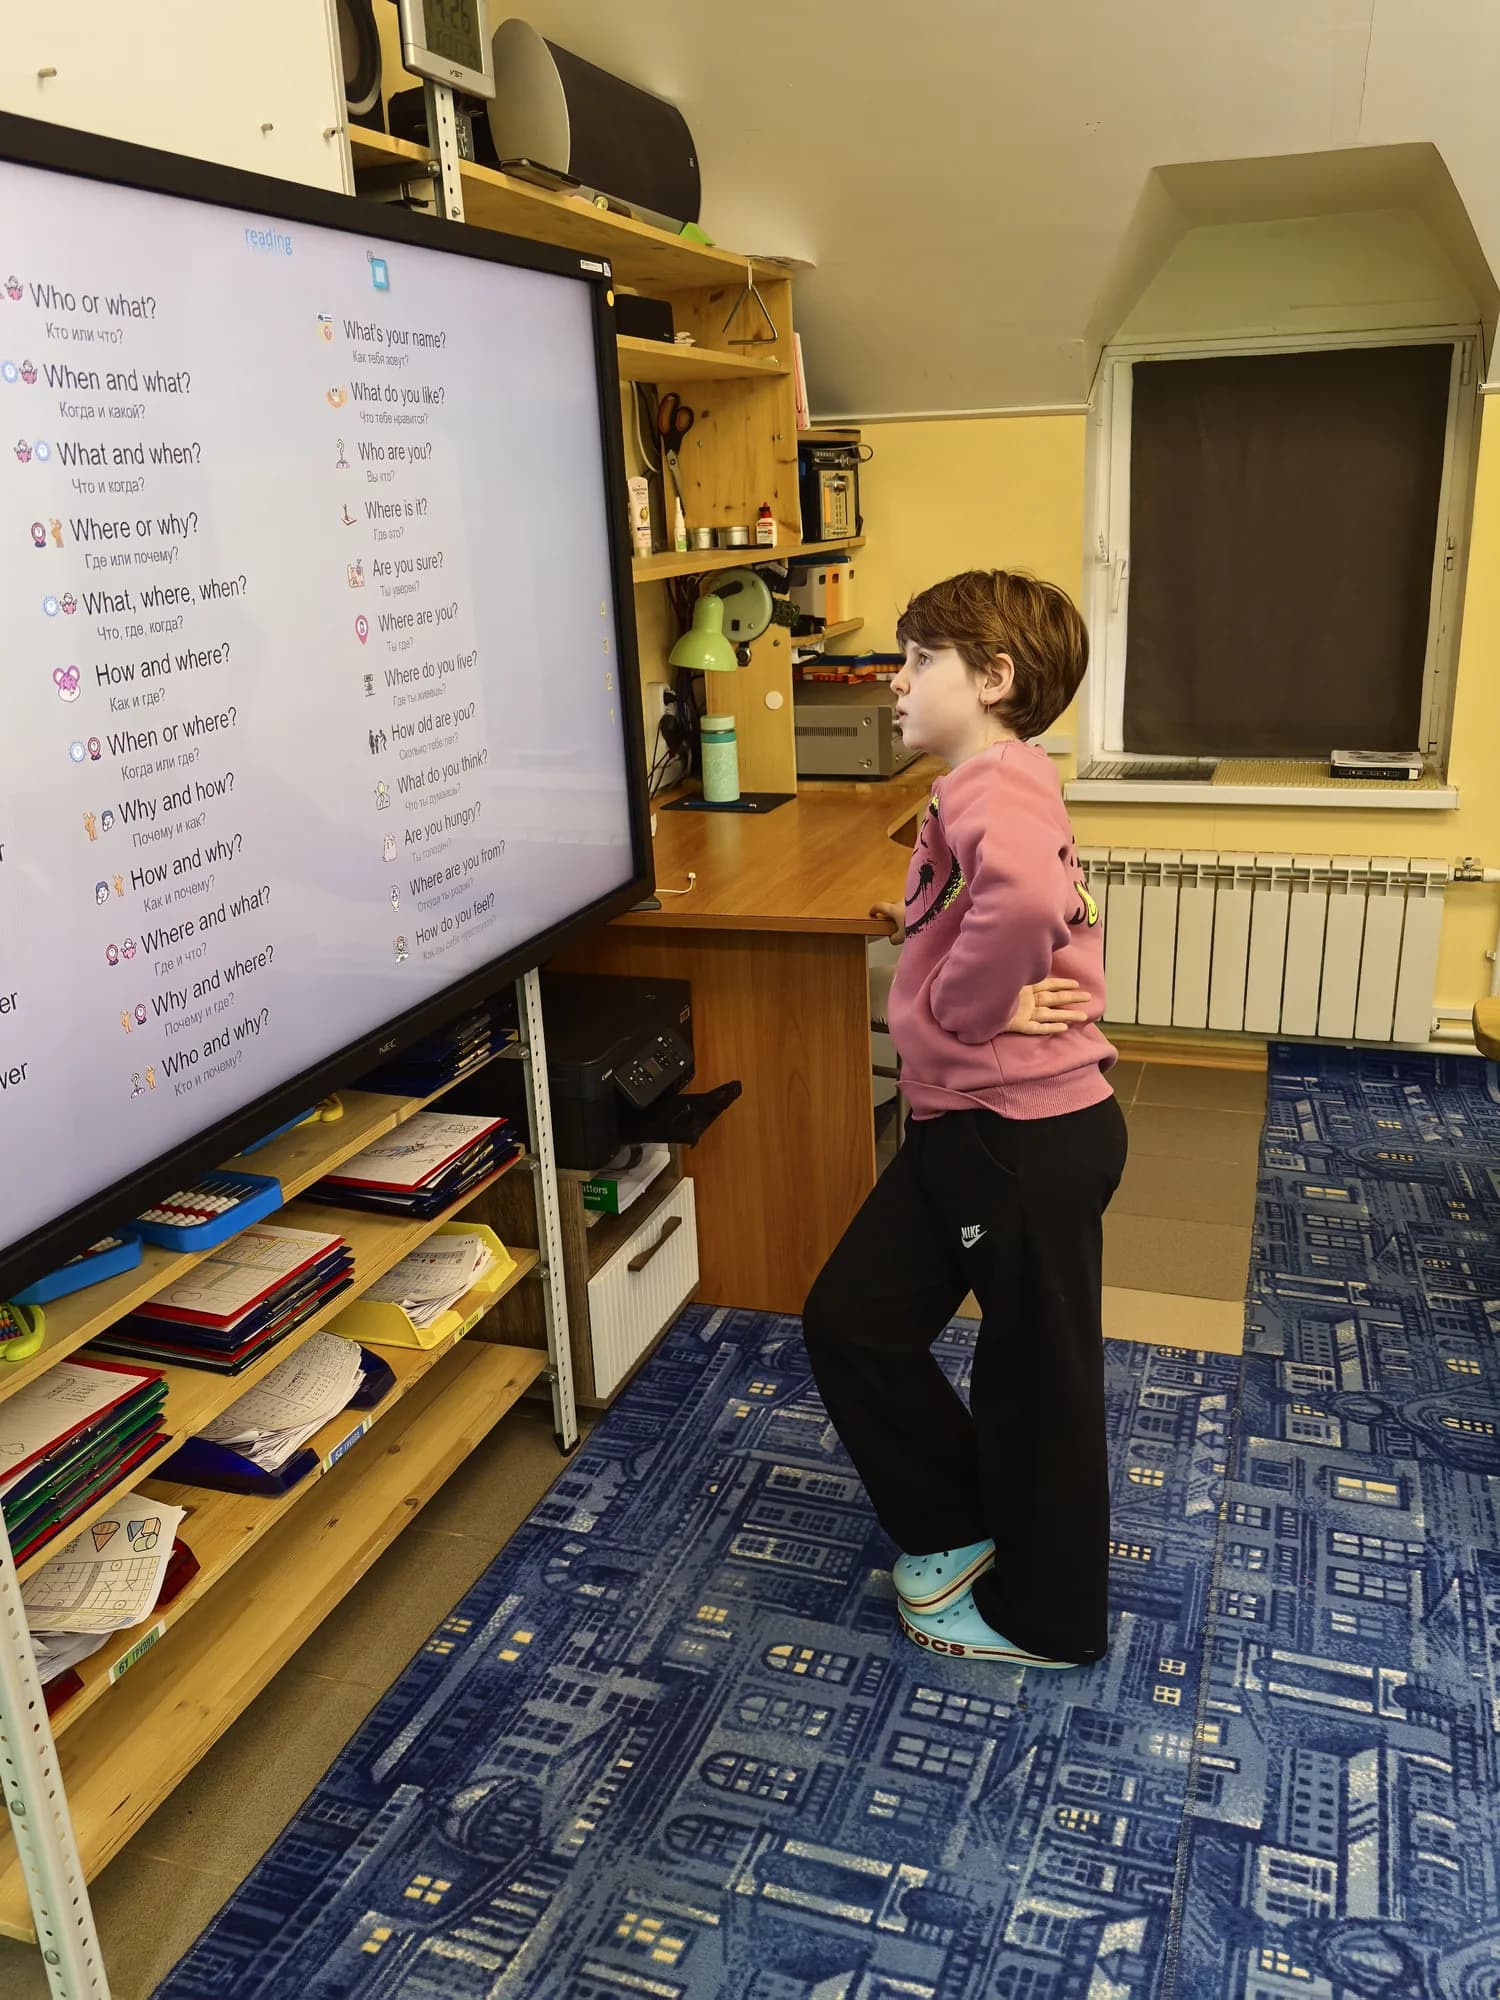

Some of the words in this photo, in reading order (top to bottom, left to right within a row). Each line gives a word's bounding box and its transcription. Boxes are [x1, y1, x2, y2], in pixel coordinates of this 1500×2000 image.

[244, 228, 292, 254] reading
[30, 282, 75, 312] Who
[83, 294, 100, 313] or
[107, 293, 156, 319] what?
[46, 322, 68, 340] Кто
[72, 327, 94, 342] или
[97, 328, 123, 344] что?
[344, 320, 383, 343] What's
[387, 329, 409, 348] your
[412, 332, 446, 348] name?
[44, 363, 100, 390] When
[106, 369, 138, 391] and
[144, 370, 190, 393] what?
[351, 382, 382, 402] What
[384, 385, 398, 402] do
[401, 389, 420, 406] you
[422, 386, 444, 404] like?
[60, 402, 94, 420] Когда
[98, 405, 106, 418] и
[109, 404, 145, 419] какой?
[57, 441, 107, 466] What
[114, 443, 144, 464] and
[149, 442, 201, 464] when?
[358, 442, 384, 461] Who
[388, 446, 405, 460] are
[408, 442, 432, 464] you?
[72, 479, 94, 494] Что
[98, 480, 105, 493] и
[108, 477, 144, 494] когда?
[365, 501, 401, 519] Where
[404, 500, 413, 517] is
[415, 498, 428, 516] it?
[70, 518, 130, 541] Where
[136, 520, 152, 536] or
[158, 512, 198, 539] why?
[86, 554, 107, 570] Где
[110, 552, 132, 566] или
[135, 547, 179, 565] почему?
[373, 559, 391, 577] Are
[395, 559, 413, 578] you
[416, 552, 444, 571] sure?
[82, 590, 136, 616] What,
[140, 585, 196, 608] where,
[199, 575, 247, 600] when?
[97, 626, 123, 641] Что,
[125, 624, 148, 639] где,
[150, 616, 184, 634] когда?
[378, 612, 414, 632] Where
[416, 611, 433, 625] are
[435, 602, 458, 626] you?
[96, 663, 134, 687] How
[141, 653, 171, 678] and
[175, 642, 230, 672] where?
[384, 668, 419, 687] Where
[422, 662, 435, 677] do
[437, 662, 455, 680] you
[457, 650, 478, 670] live?
[110, 696, 130, 712] Как
[132, 695, 140, 708] и
[142, 688, 166, 707] где?
[107, 730, 158, 756] When
[162, 724, 178, 742] or
[183, 706, 237, 738] where?
[391, 723, 415, 741] How
[417, 717, 433, 733] old
[435, 715, 451, 729] are
[453, 702, 476, 727] you?
[121, 764, 153, 781] Когда
[156, 758, 176, 772] или
[178, 748, 200, 768] где?
[397, 773, 425, 794] What
[427, 766, 440, 782] do
[442, 763, 460, 782] you
[461, 749, 488, 772] think?
[119, 798, 157, 825] Why
[163, 785, 192, 811] and
[196, 772, 234, 800] how?
[132, 823, 173, 848] Почему
[176, 820, 183, 834] и
[186, 812, 206, 830] как?
[404, 828, 421, 846] Are
[424, 821, 443, 842] you
[444, 801, 482, 829] hungry?
[131, 866, 168, 890] How
[173, 850, 201, 875] and
[205, 834, 243, 864] why?
[410, 872, 443, 896] Where
[445, 862, 461, 879] are
[462, 856, 479, 877] you
[481, 840, 506, 865] from?
[144, 896, 162, 912] Как
[165, 892, 172, 904] и
[174, 875, 215, 901] почему?
[141, 919, 194, 954] Where
[199, 905, 226, 931] and
[230, 886, 271, 918] what?
[415, 924, 438, 946] How
[441, 914, 453, 931] do
[455, 908, 472, 929] you
[474, 893, 495, 917] feel?
[154, 959, 174, 976] Где
[177, 955, 183, 968] и
[185, 942, 207, 964] что?
[152, 989, 188, 1016] Why
[193, 970, 220, 999] and
[224, 945, 274, 984] where?
[164, 1011, 202, 1037] Почему
[205, 1005, 212, 1017] и
[213, 992, 235, 1014] где?
[162, 1049, 199, 1078] Who
[203, 1029, 230, 1058] and
[234, 1008, 269, 1041] why?
[379, 1038, 397, 1056] NEC
[174, 1080, 192, 1096] Кто
[195, 1074, 201, 1086] и
[203, 1050, 242, 1081] почему?
[961, 1224, 981, 1239] NIKE
[118, 1657, 129, 1674] 61
